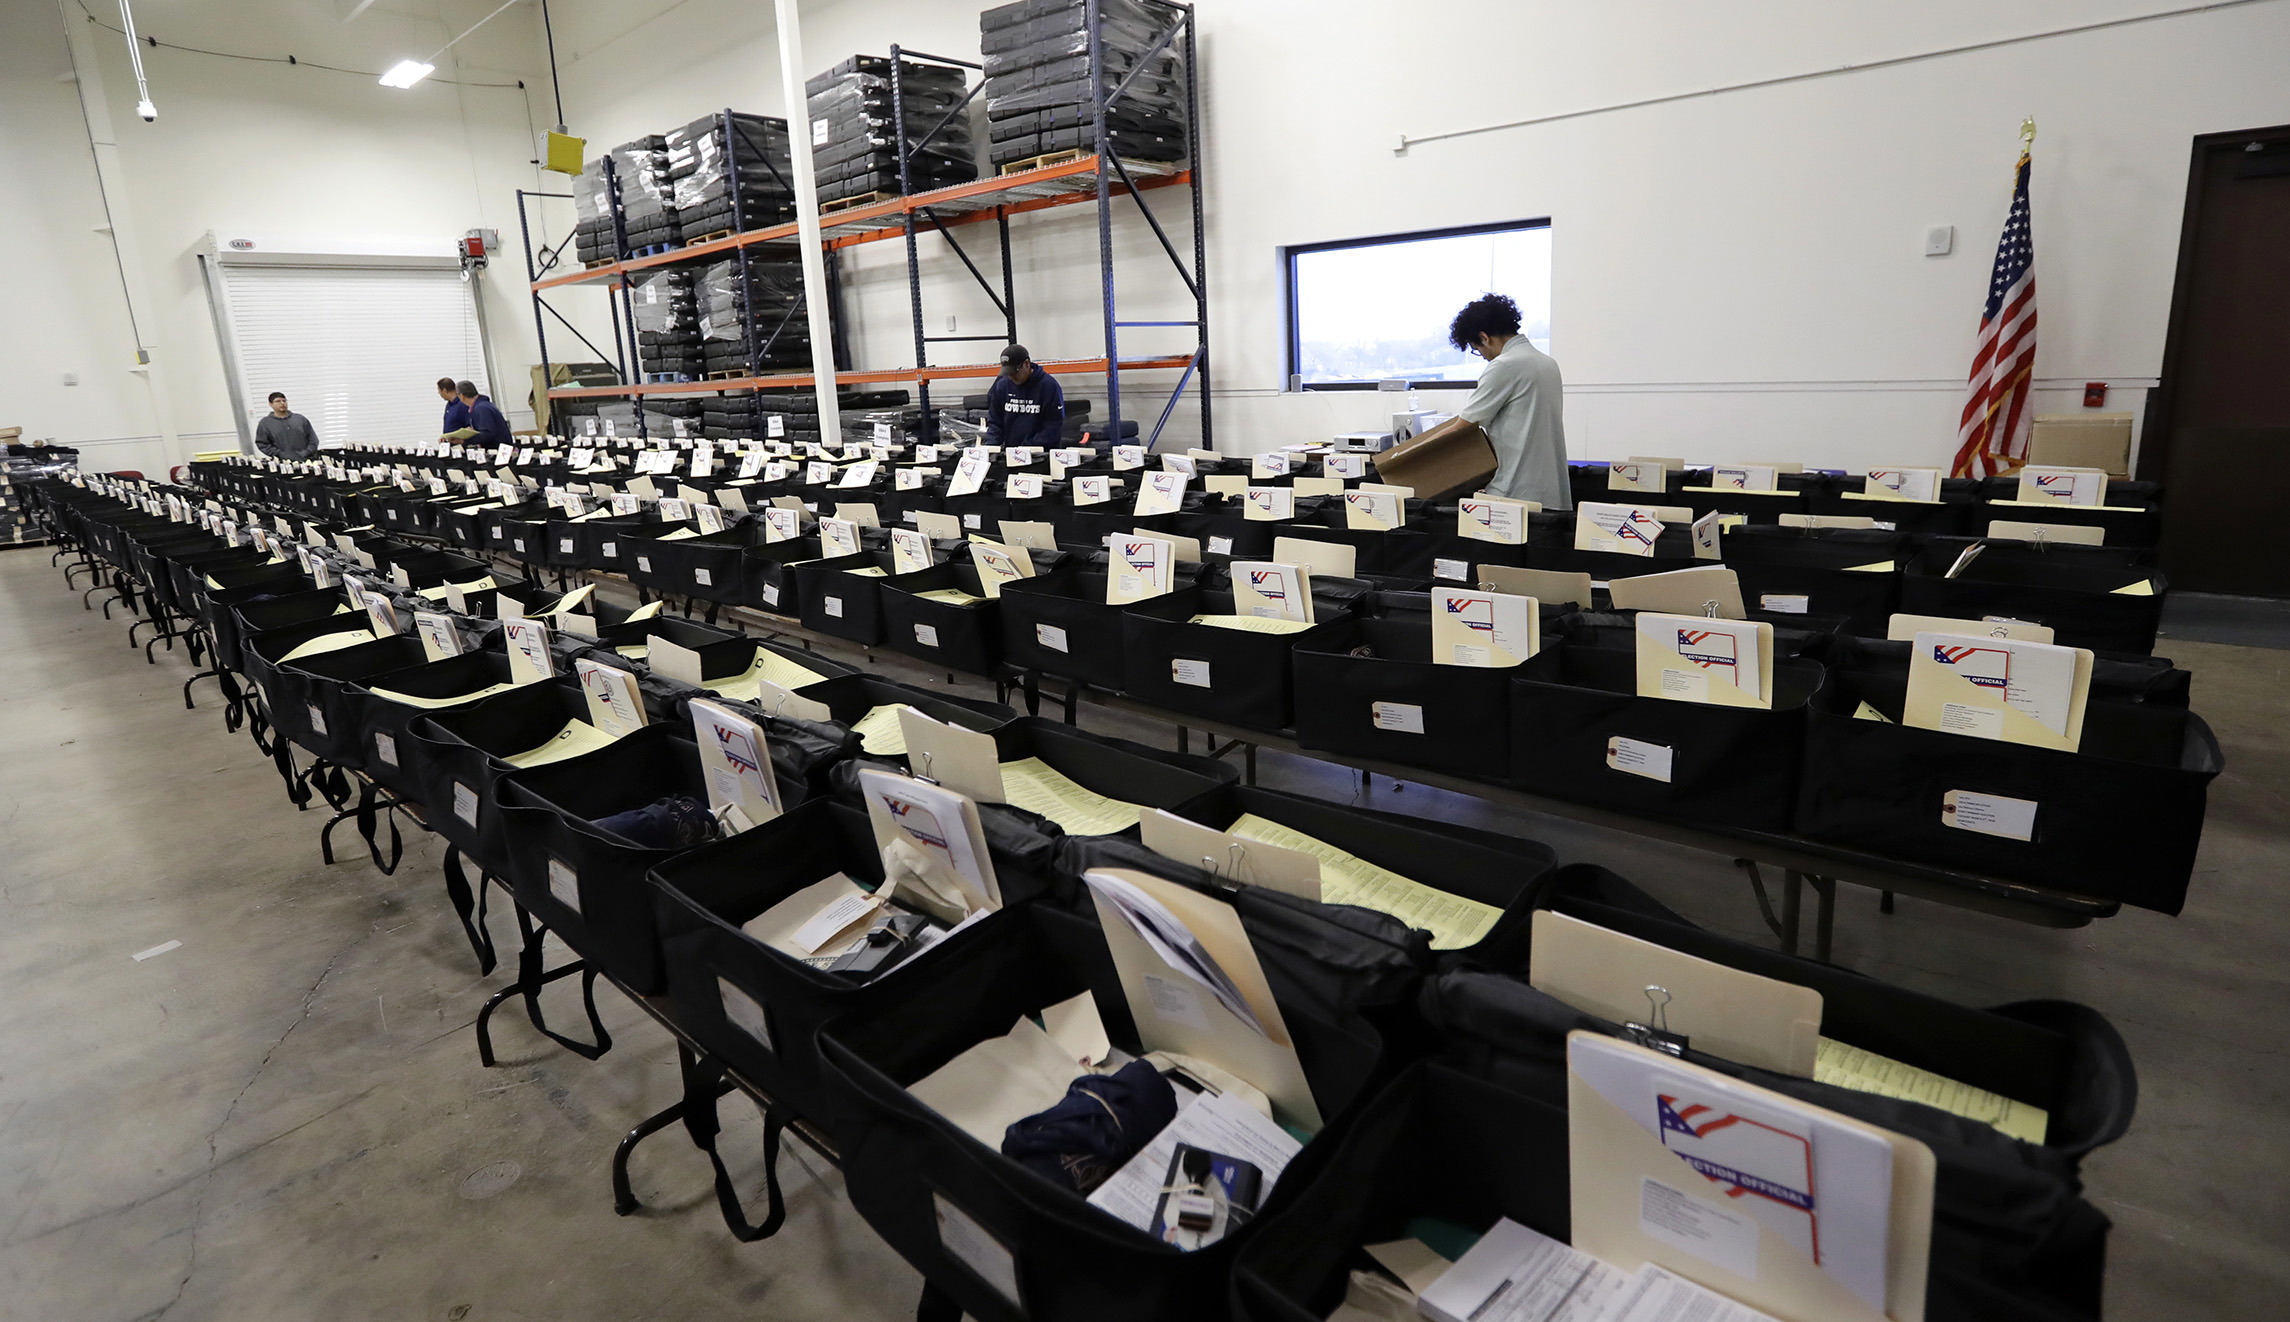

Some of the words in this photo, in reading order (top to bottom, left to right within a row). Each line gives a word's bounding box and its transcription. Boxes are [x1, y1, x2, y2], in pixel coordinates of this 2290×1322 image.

[1005, 402, 1040, 413] COWBOYS
[1709, 656, 1734, 664] OFFICIAL
[1971, 677, 2004, 686] OFFICIAL
[1740, 1173, 1809, 1207] OFFICIAL
